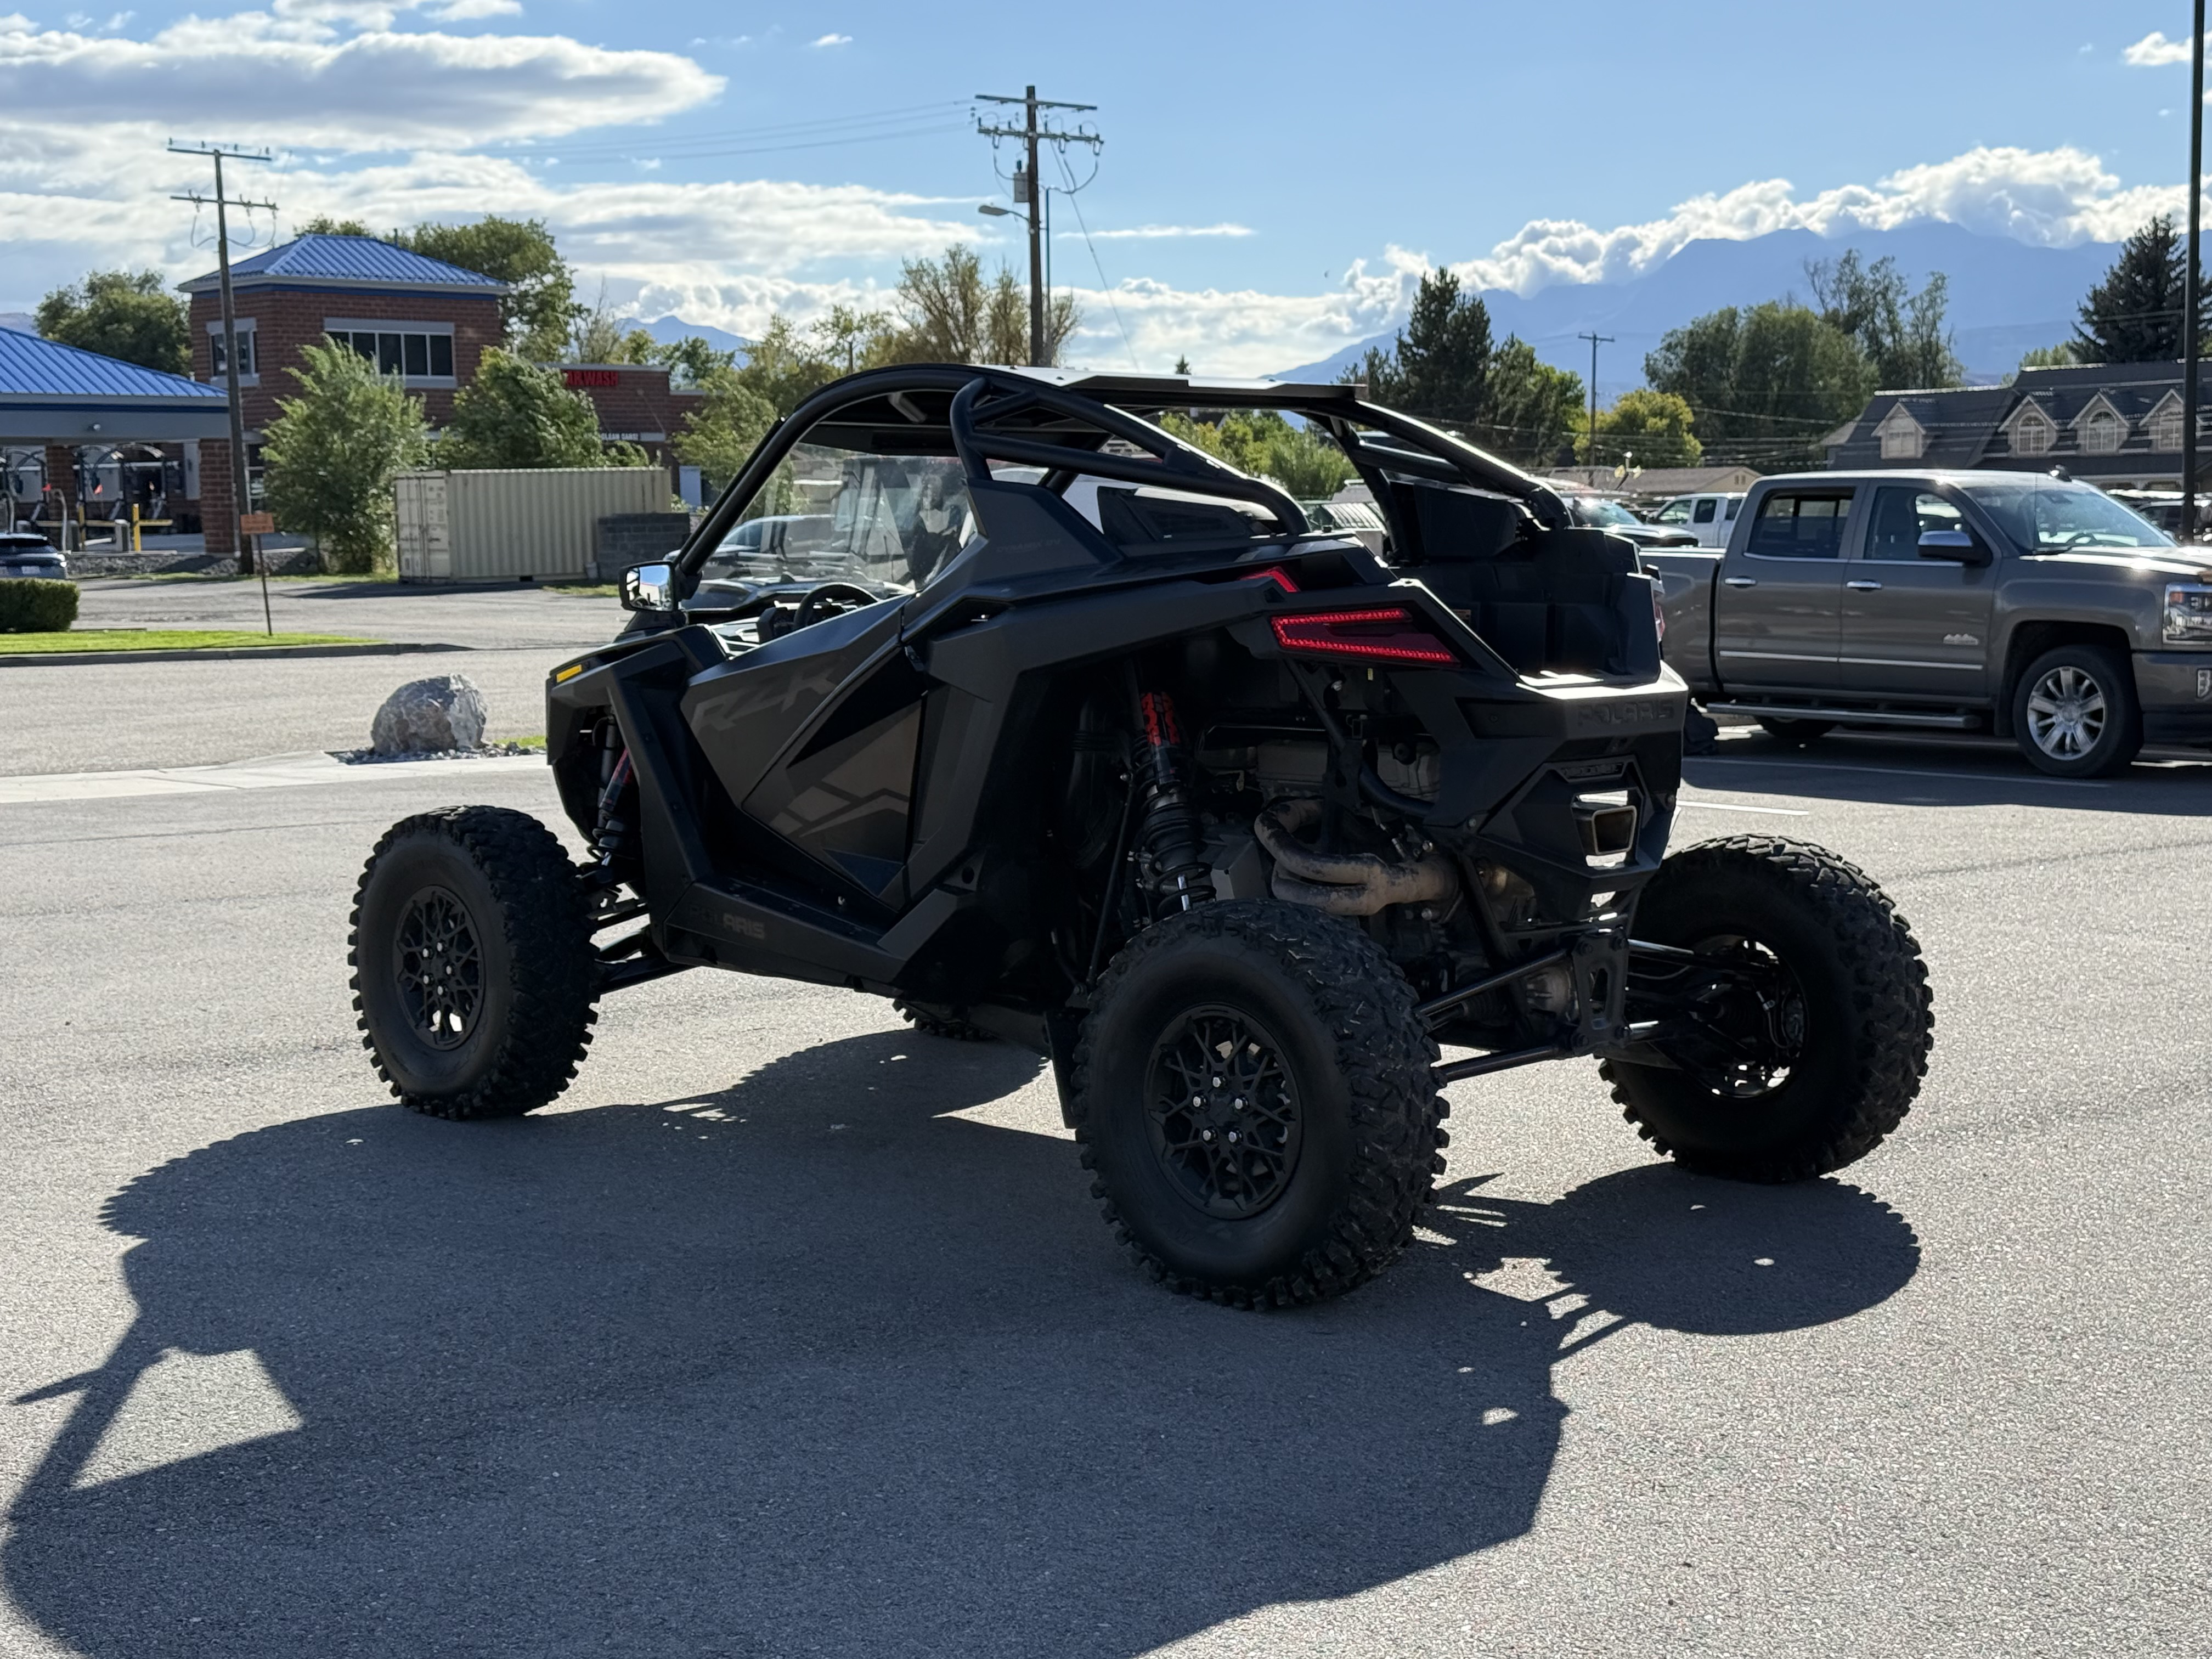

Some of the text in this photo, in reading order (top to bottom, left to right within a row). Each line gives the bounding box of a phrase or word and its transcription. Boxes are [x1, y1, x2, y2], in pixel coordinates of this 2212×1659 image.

[562, 370, 618, 386] AR WASH
[1577, 700, 1674, 726] POLARIS
